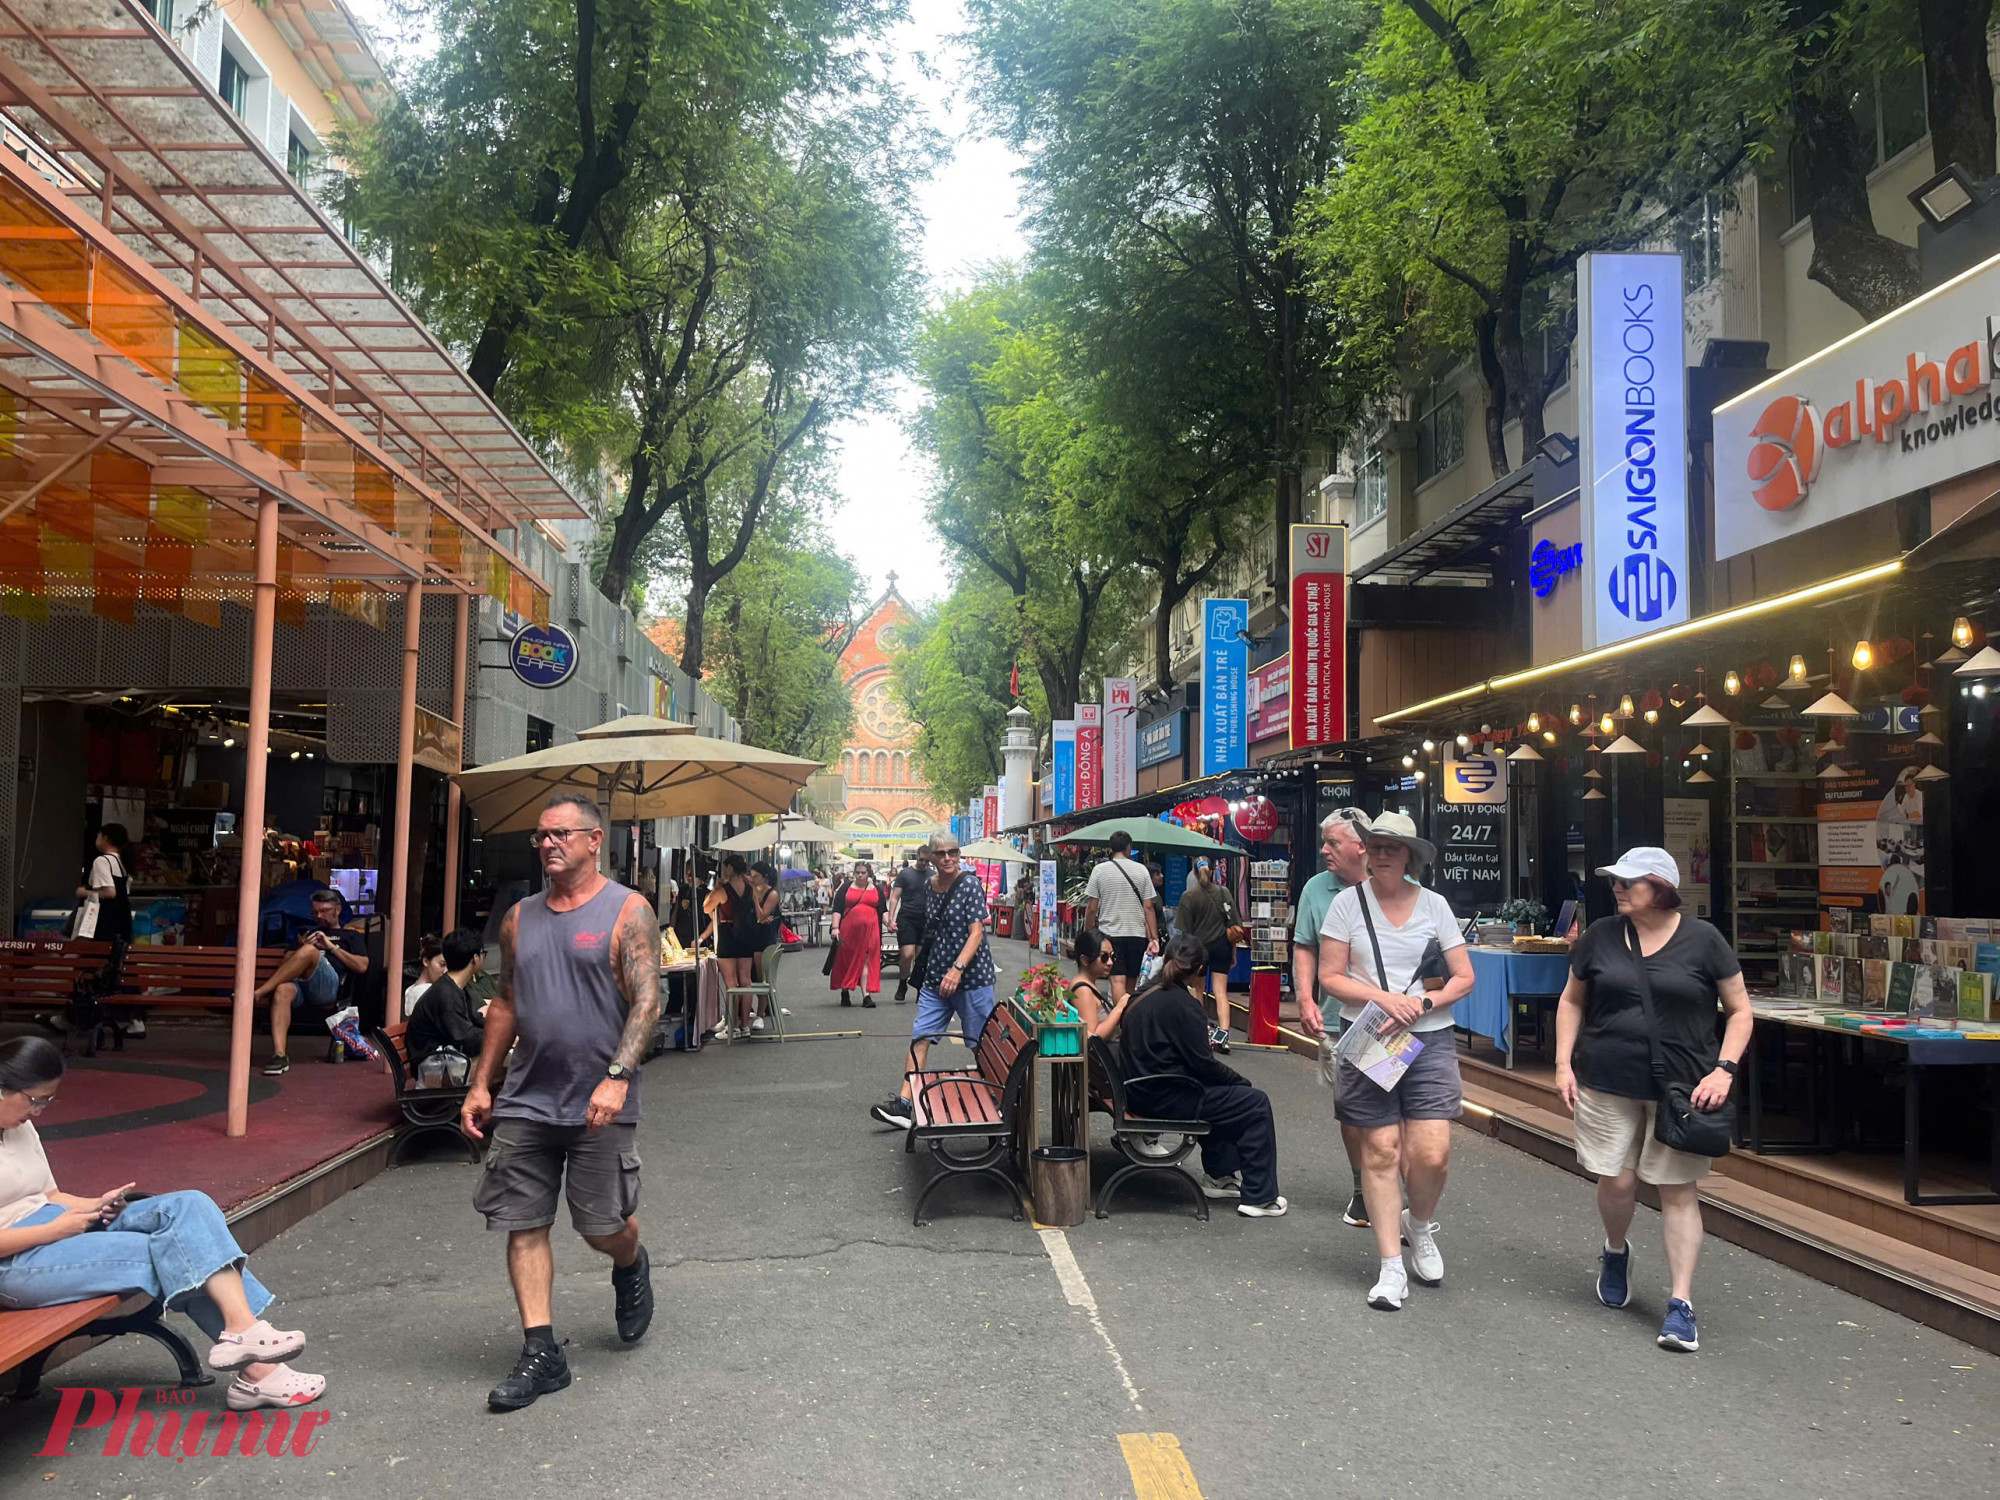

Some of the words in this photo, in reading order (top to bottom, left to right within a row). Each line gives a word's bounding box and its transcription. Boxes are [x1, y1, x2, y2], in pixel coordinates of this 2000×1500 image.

[1305, 582, 1320, 600] THẬT
[1323, 583, 1331, 610] HOUSE
[1306, 614, 1318, 626] GIA
[1304, 628, 1318, 648] QUỐC
[1323, 612, 1331, 658] PUBLISHING
[519, 641, 568, 664] BOOK
[1306, 650, 1320, 661] TRỊ
[516, 656, 566, 674] CAFE
[1305, 662, 1318, 686] CHÍNH
[1212, 675, 1228, 700] BẢN
[1230, 666, 1238, 690] HOUSE
[1323, 660, 1331, 700] POLITICAL
[1112, 690, 1130, 704] PN
[1304, 687, 1318, 702] BẢN
[1212, 704, 1227, 734] XUẤT
[1230, 691, 1238, 734] PUBLISHING
[1304, 704, 1318, 723] XUẤT
[1323, 702, 1331, 741] NATIONAL
[1081, 730, 1090, 738] A
[1230, 735, 1238, 748] TRE
[1305, 725, 1318, 741] NHÀ
[1213, 737, 1227, 763] NHÀ
[1321, 786, 1350, 799] CHỌN
[1451, 824, 1492, 840] 24/7
[1443, 866, 1468, 882] VIỆT
[1472, 869, 1500, 880] NAM
